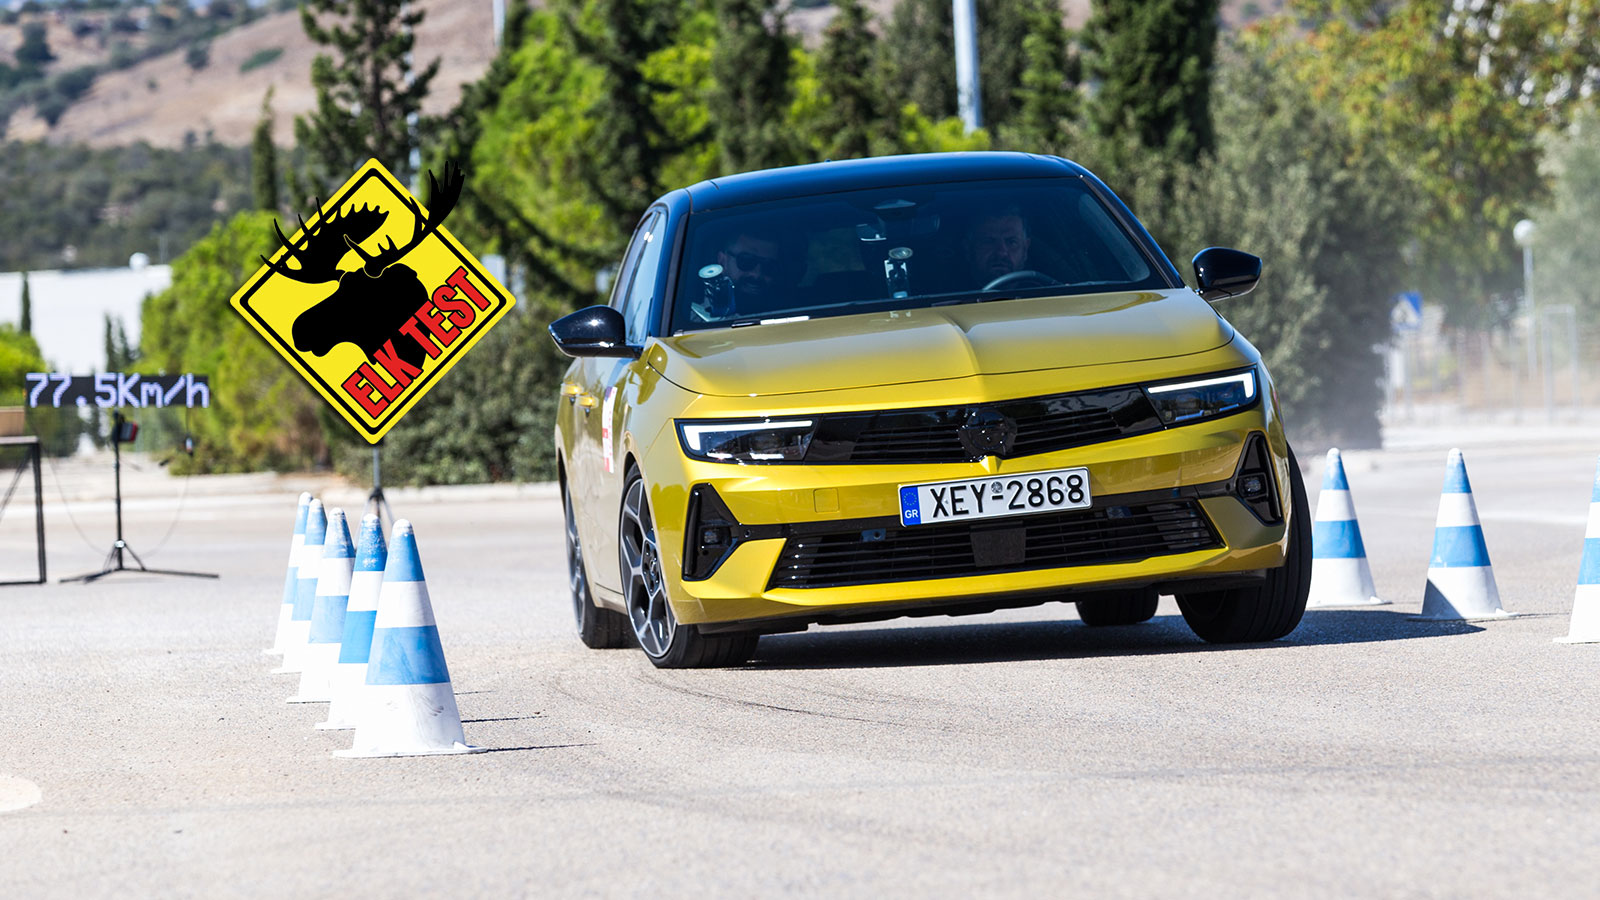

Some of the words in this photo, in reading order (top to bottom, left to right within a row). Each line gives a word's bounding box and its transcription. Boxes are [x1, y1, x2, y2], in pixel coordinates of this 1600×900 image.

[26, 372, 210, 408] 77.5Km/h
[904, 508, 919, 519] GR
[929, 474, 1085, 518] XEY-2868
